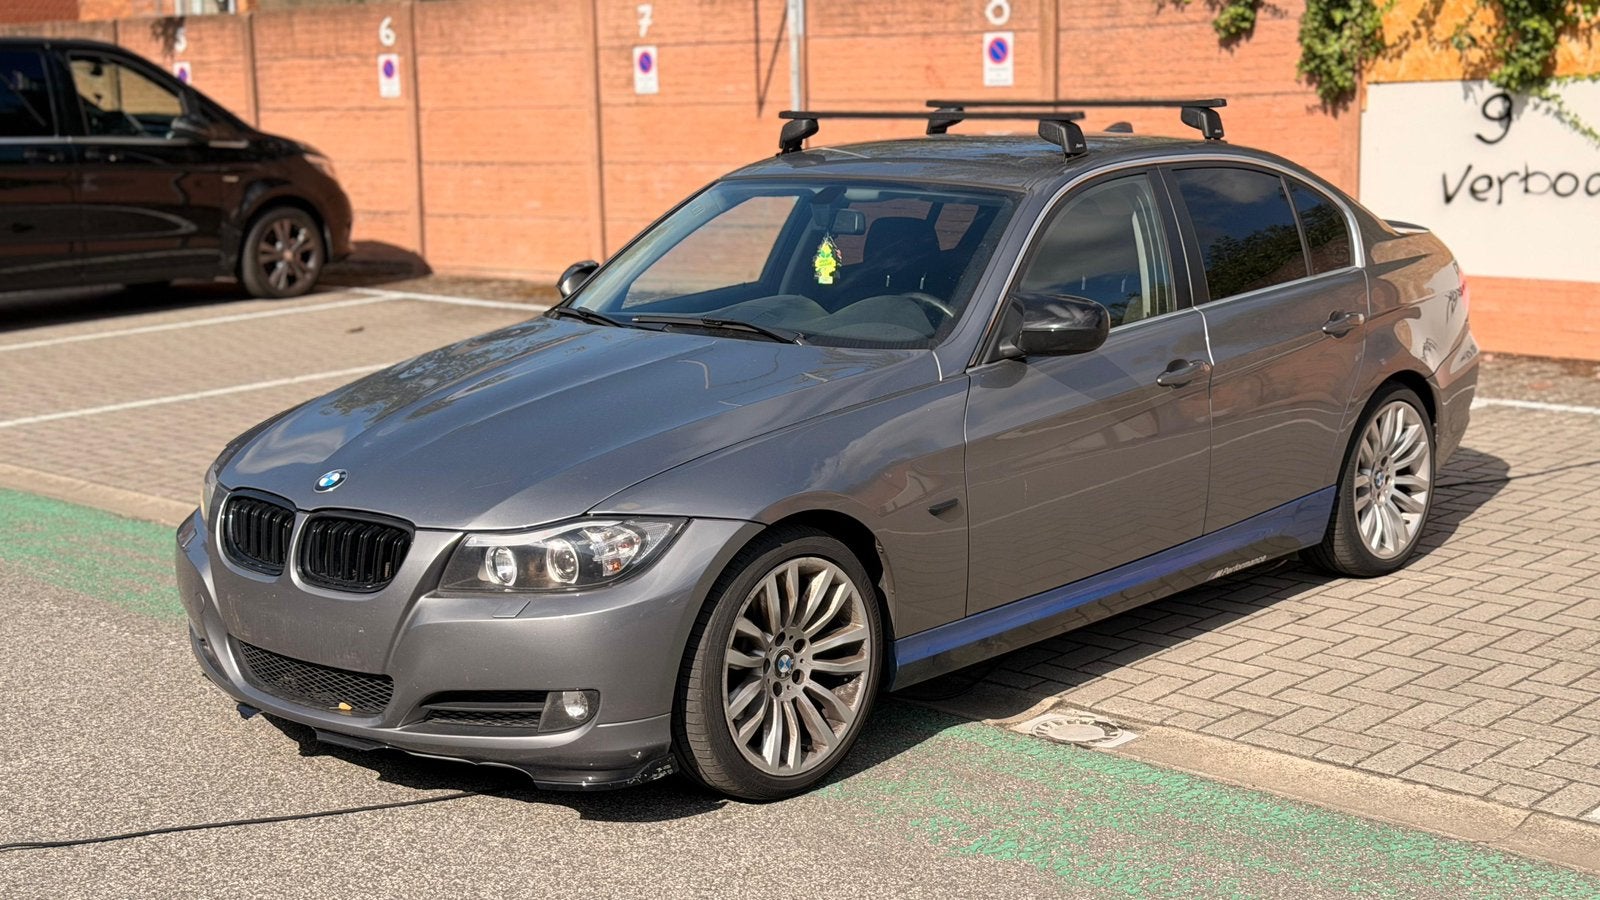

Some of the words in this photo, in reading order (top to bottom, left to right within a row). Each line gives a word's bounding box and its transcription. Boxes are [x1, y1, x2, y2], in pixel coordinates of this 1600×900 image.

[379, 15, 397, 47] 6
[636, 3, 653, 38] 7
[1474, 92, 1514, 145] 9
